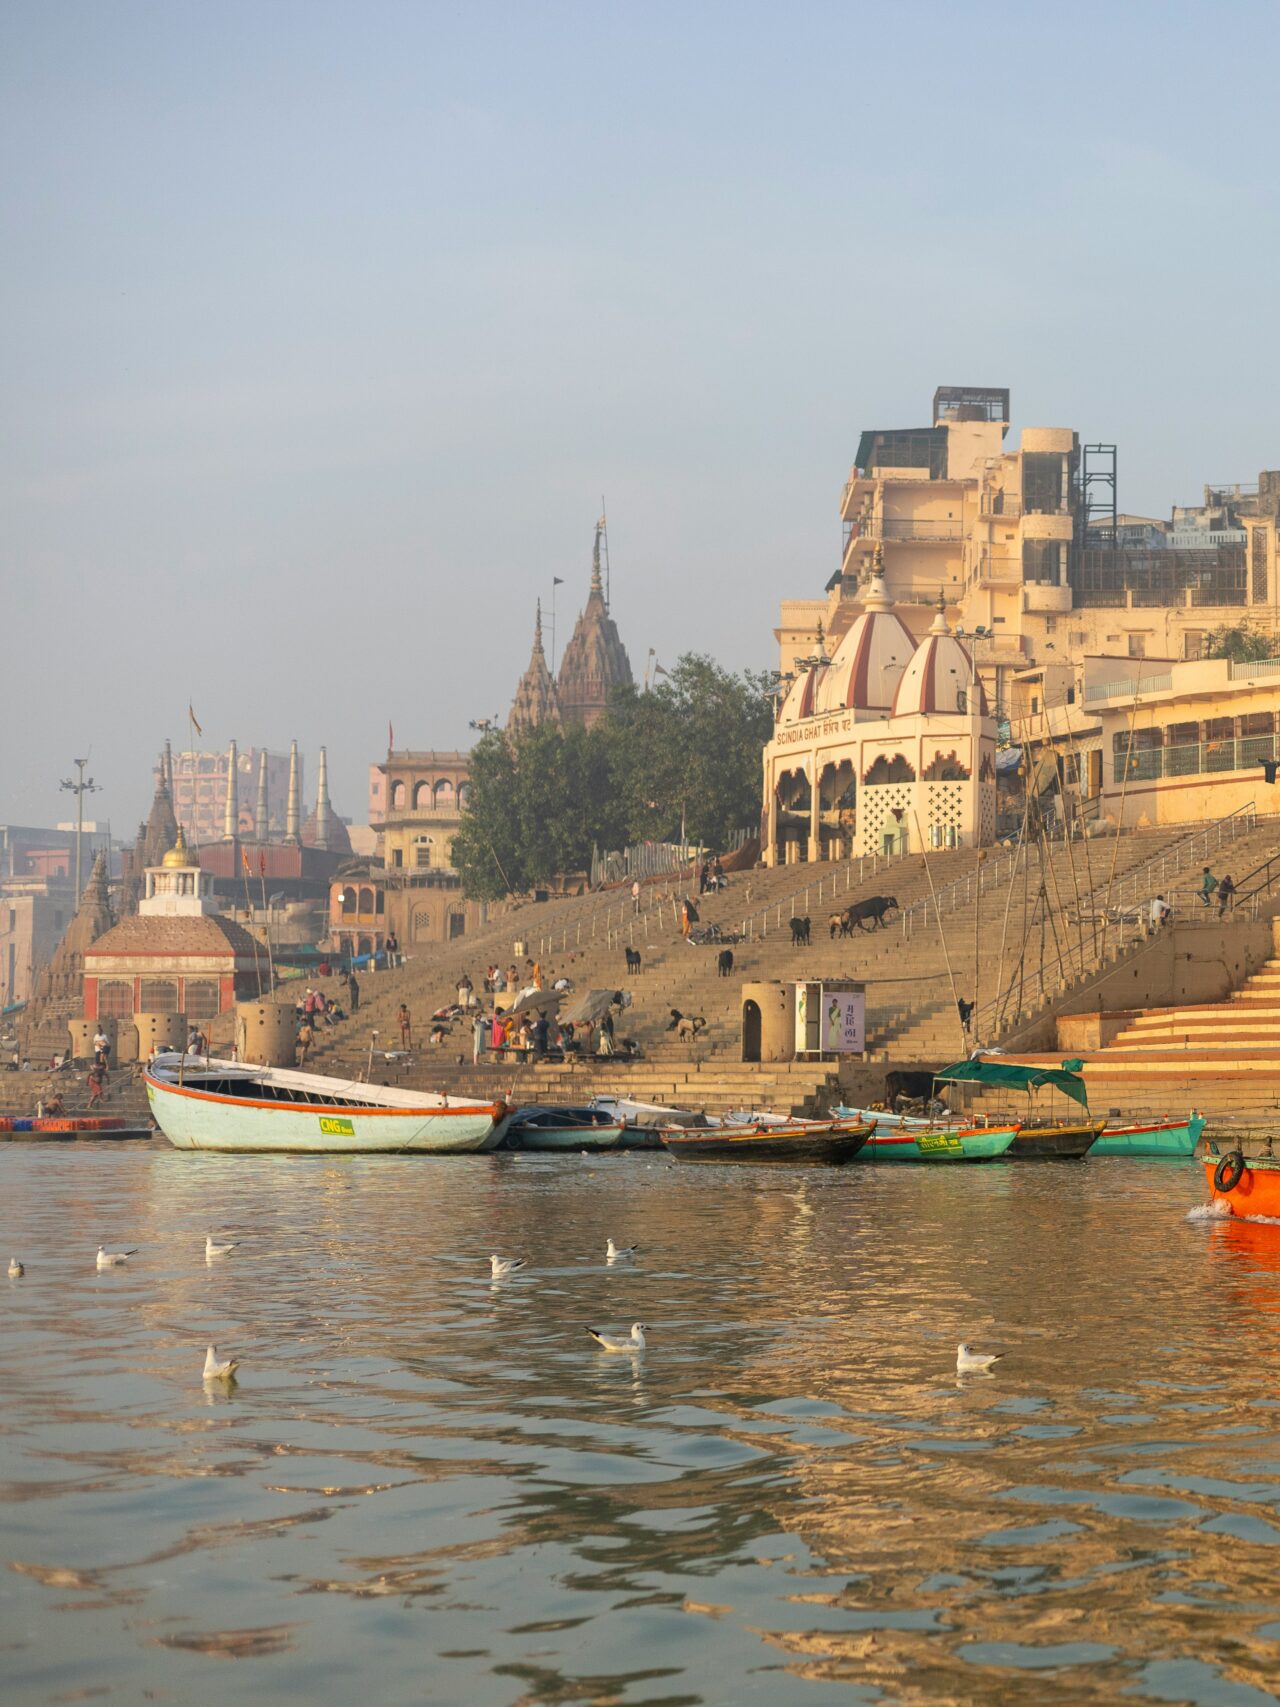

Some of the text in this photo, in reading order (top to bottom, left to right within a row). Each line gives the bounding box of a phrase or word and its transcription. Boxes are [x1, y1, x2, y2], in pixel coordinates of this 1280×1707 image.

[777, 727, 803, 745] SCINDIA
[804, 725, 821, 740] GHAT
[321, 1118, 341, 1133] CNG
